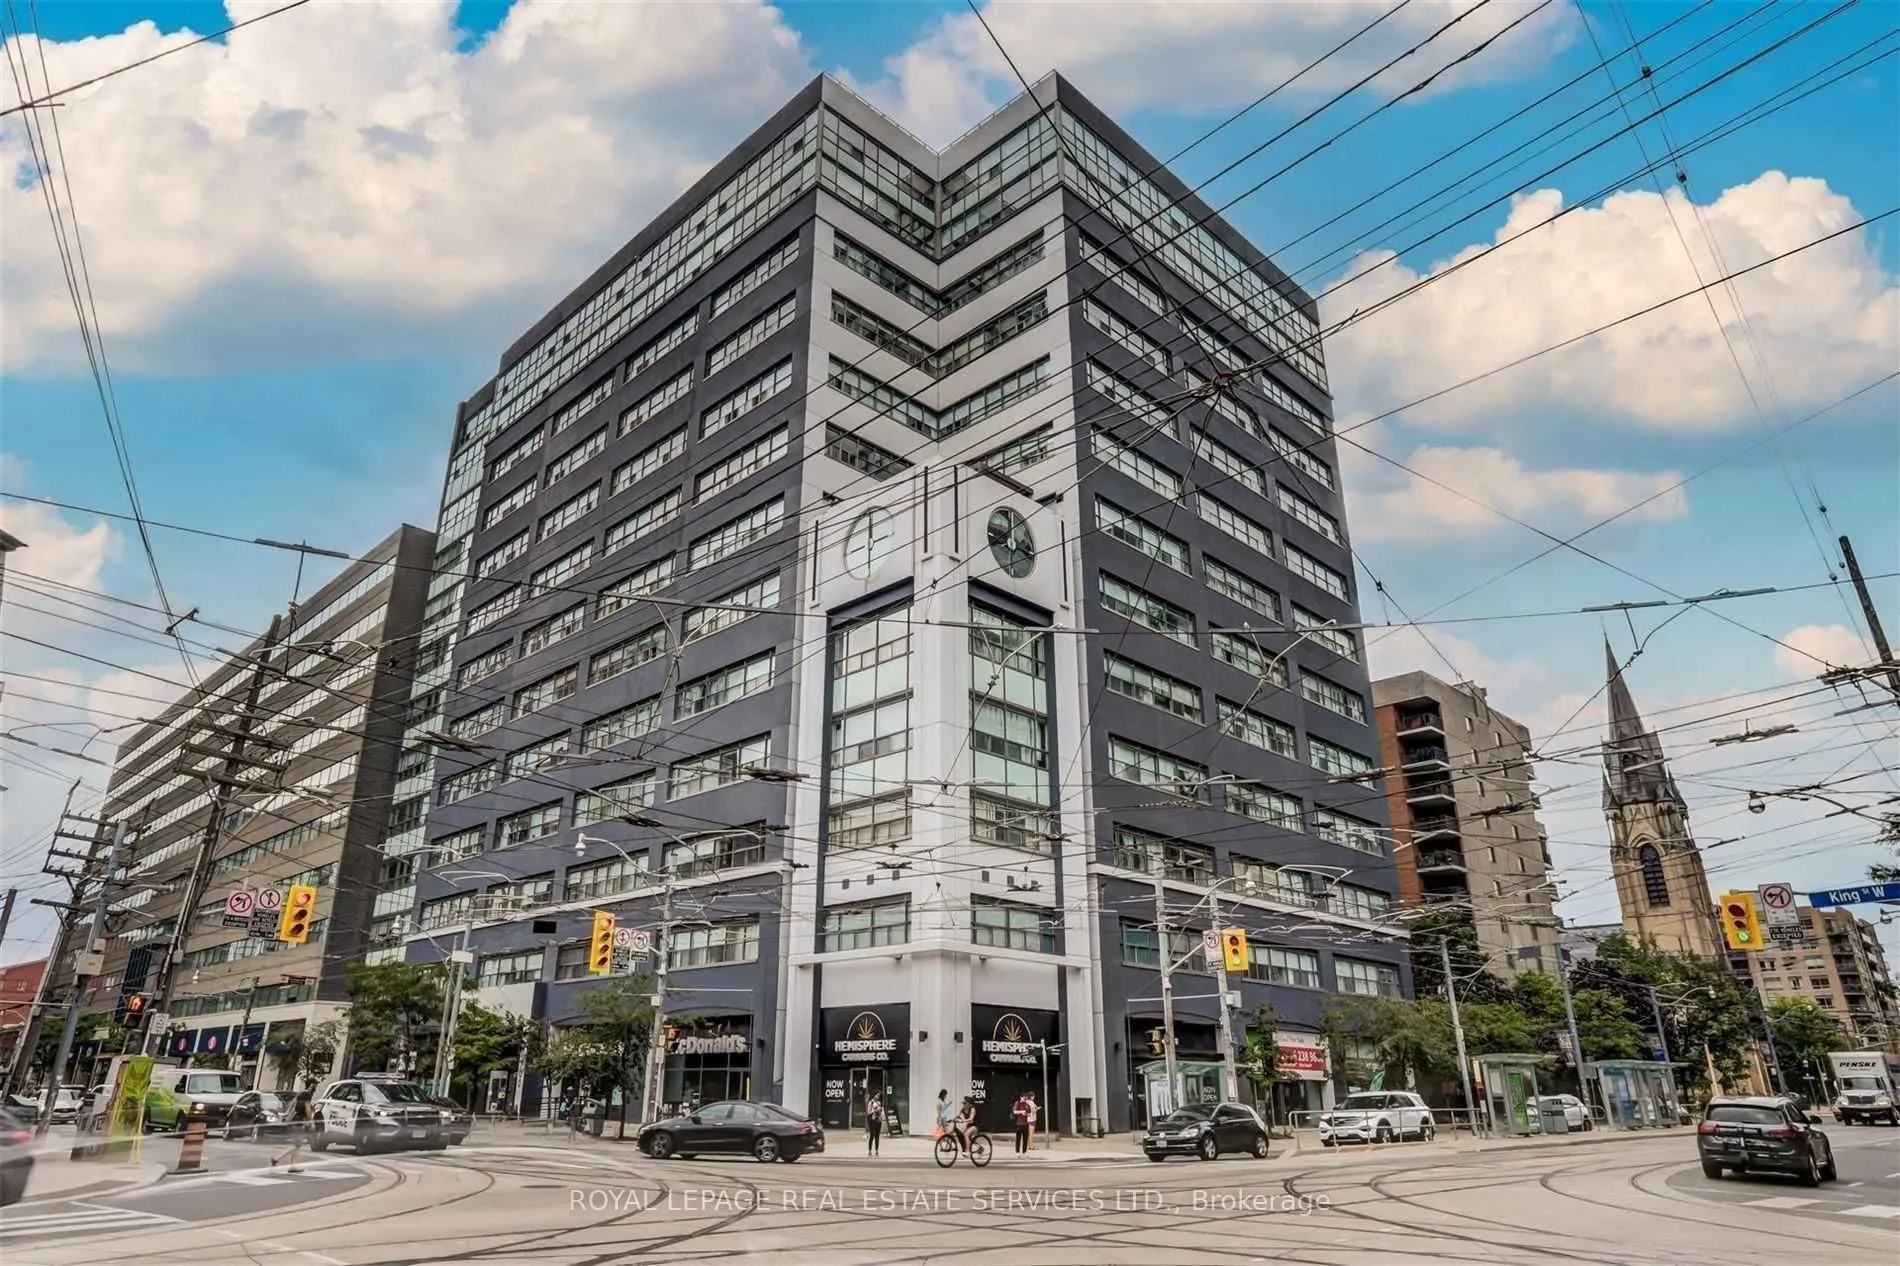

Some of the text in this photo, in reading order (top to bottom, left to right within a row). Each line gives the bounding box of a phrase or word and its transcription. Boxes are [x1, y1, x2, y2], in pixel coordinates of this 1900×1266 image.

[1829, 890, 1860, 903] King
[1872, 886, 1885, 898] W
[672, 1034, 747, 1054] cDonald's
[834, 1039, 897, 1052] HEMISPHERE
[826, 1080, 844, 1089] NOW
[971, 1080, 985, 1089] OW
[825, 1089, 845, 1098] OPEN
[970, 1089, 986, 1099] PEN
